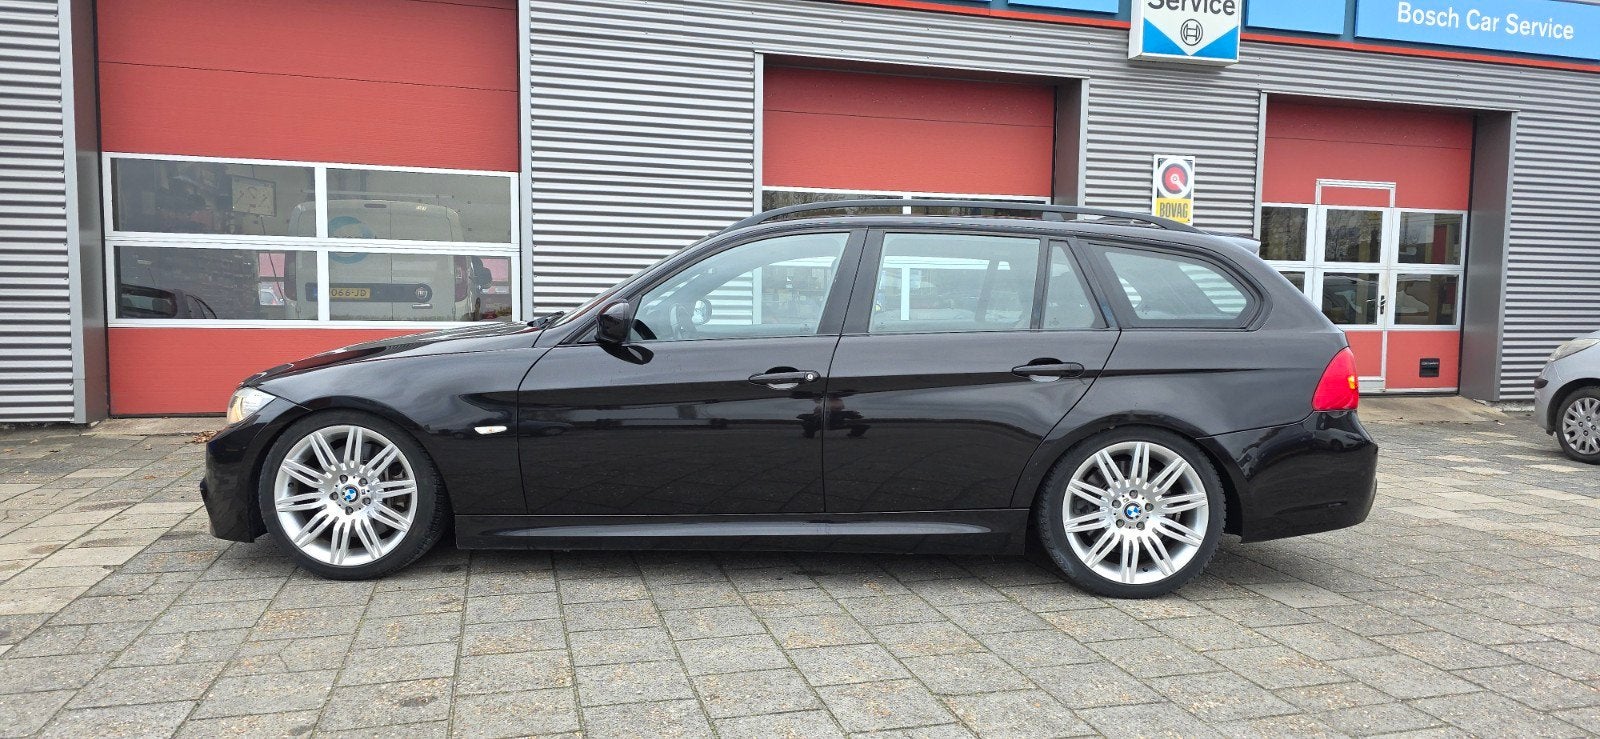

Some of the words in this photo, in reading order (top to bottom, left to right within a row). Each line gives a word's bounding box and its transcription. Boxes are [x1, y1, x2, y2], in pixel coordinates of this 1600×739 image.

[1397, 1, 1459, 29] Bosch
[1466, 8, 1500, 33] Car
[1504, 12, 1575, 40] Service
[1160, 202, 1188, 218] BOVAG
